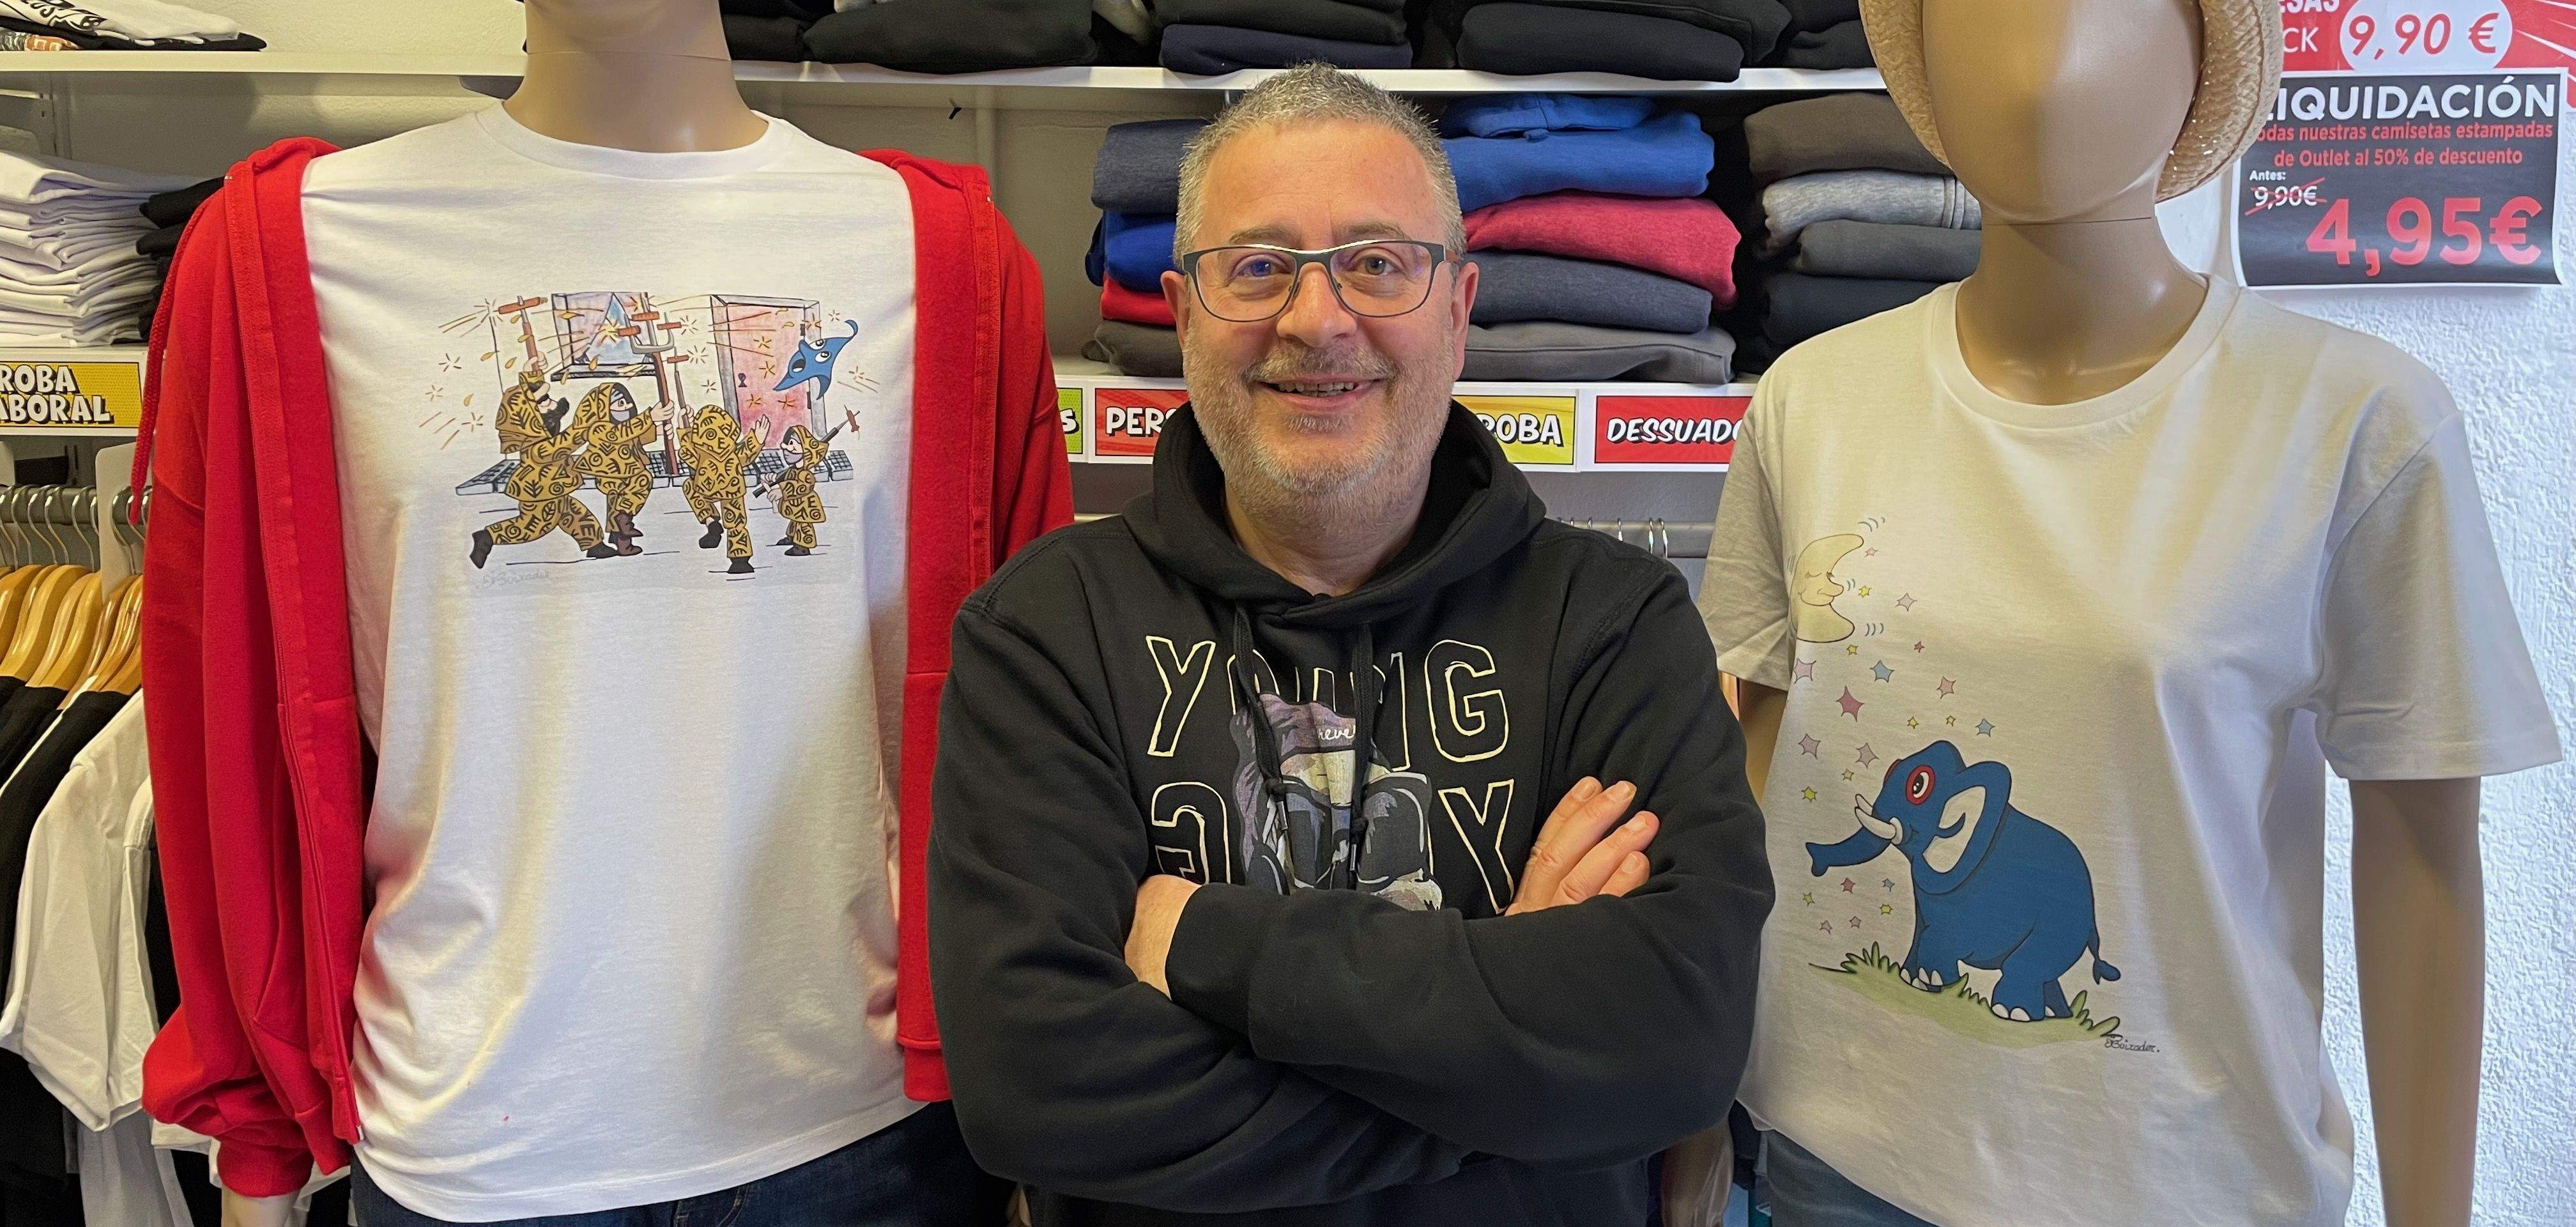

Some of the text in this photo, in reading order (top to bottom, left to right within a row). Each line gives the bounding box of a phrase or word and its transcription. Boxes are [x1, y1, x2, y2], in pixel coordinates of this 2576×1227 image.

[2349, 13, 2499, 59] 9,90 €
[2267, 75, 2555, 121] IQUIDACIÓN
[2256, 121, 2554, 141] odas nuestras camisetas estampadas
[2274, 147, 2523, 167] de Outlet al 50% de descuento
[2249, 170, 2287, 181] Antes:
[2254, 186, 2318, 210] 9,90€
[2306, 195, 2543, 277] 4,95€
[0, 365, 77, 393] ROBA
[1106, 406, 1179, 435] PER
